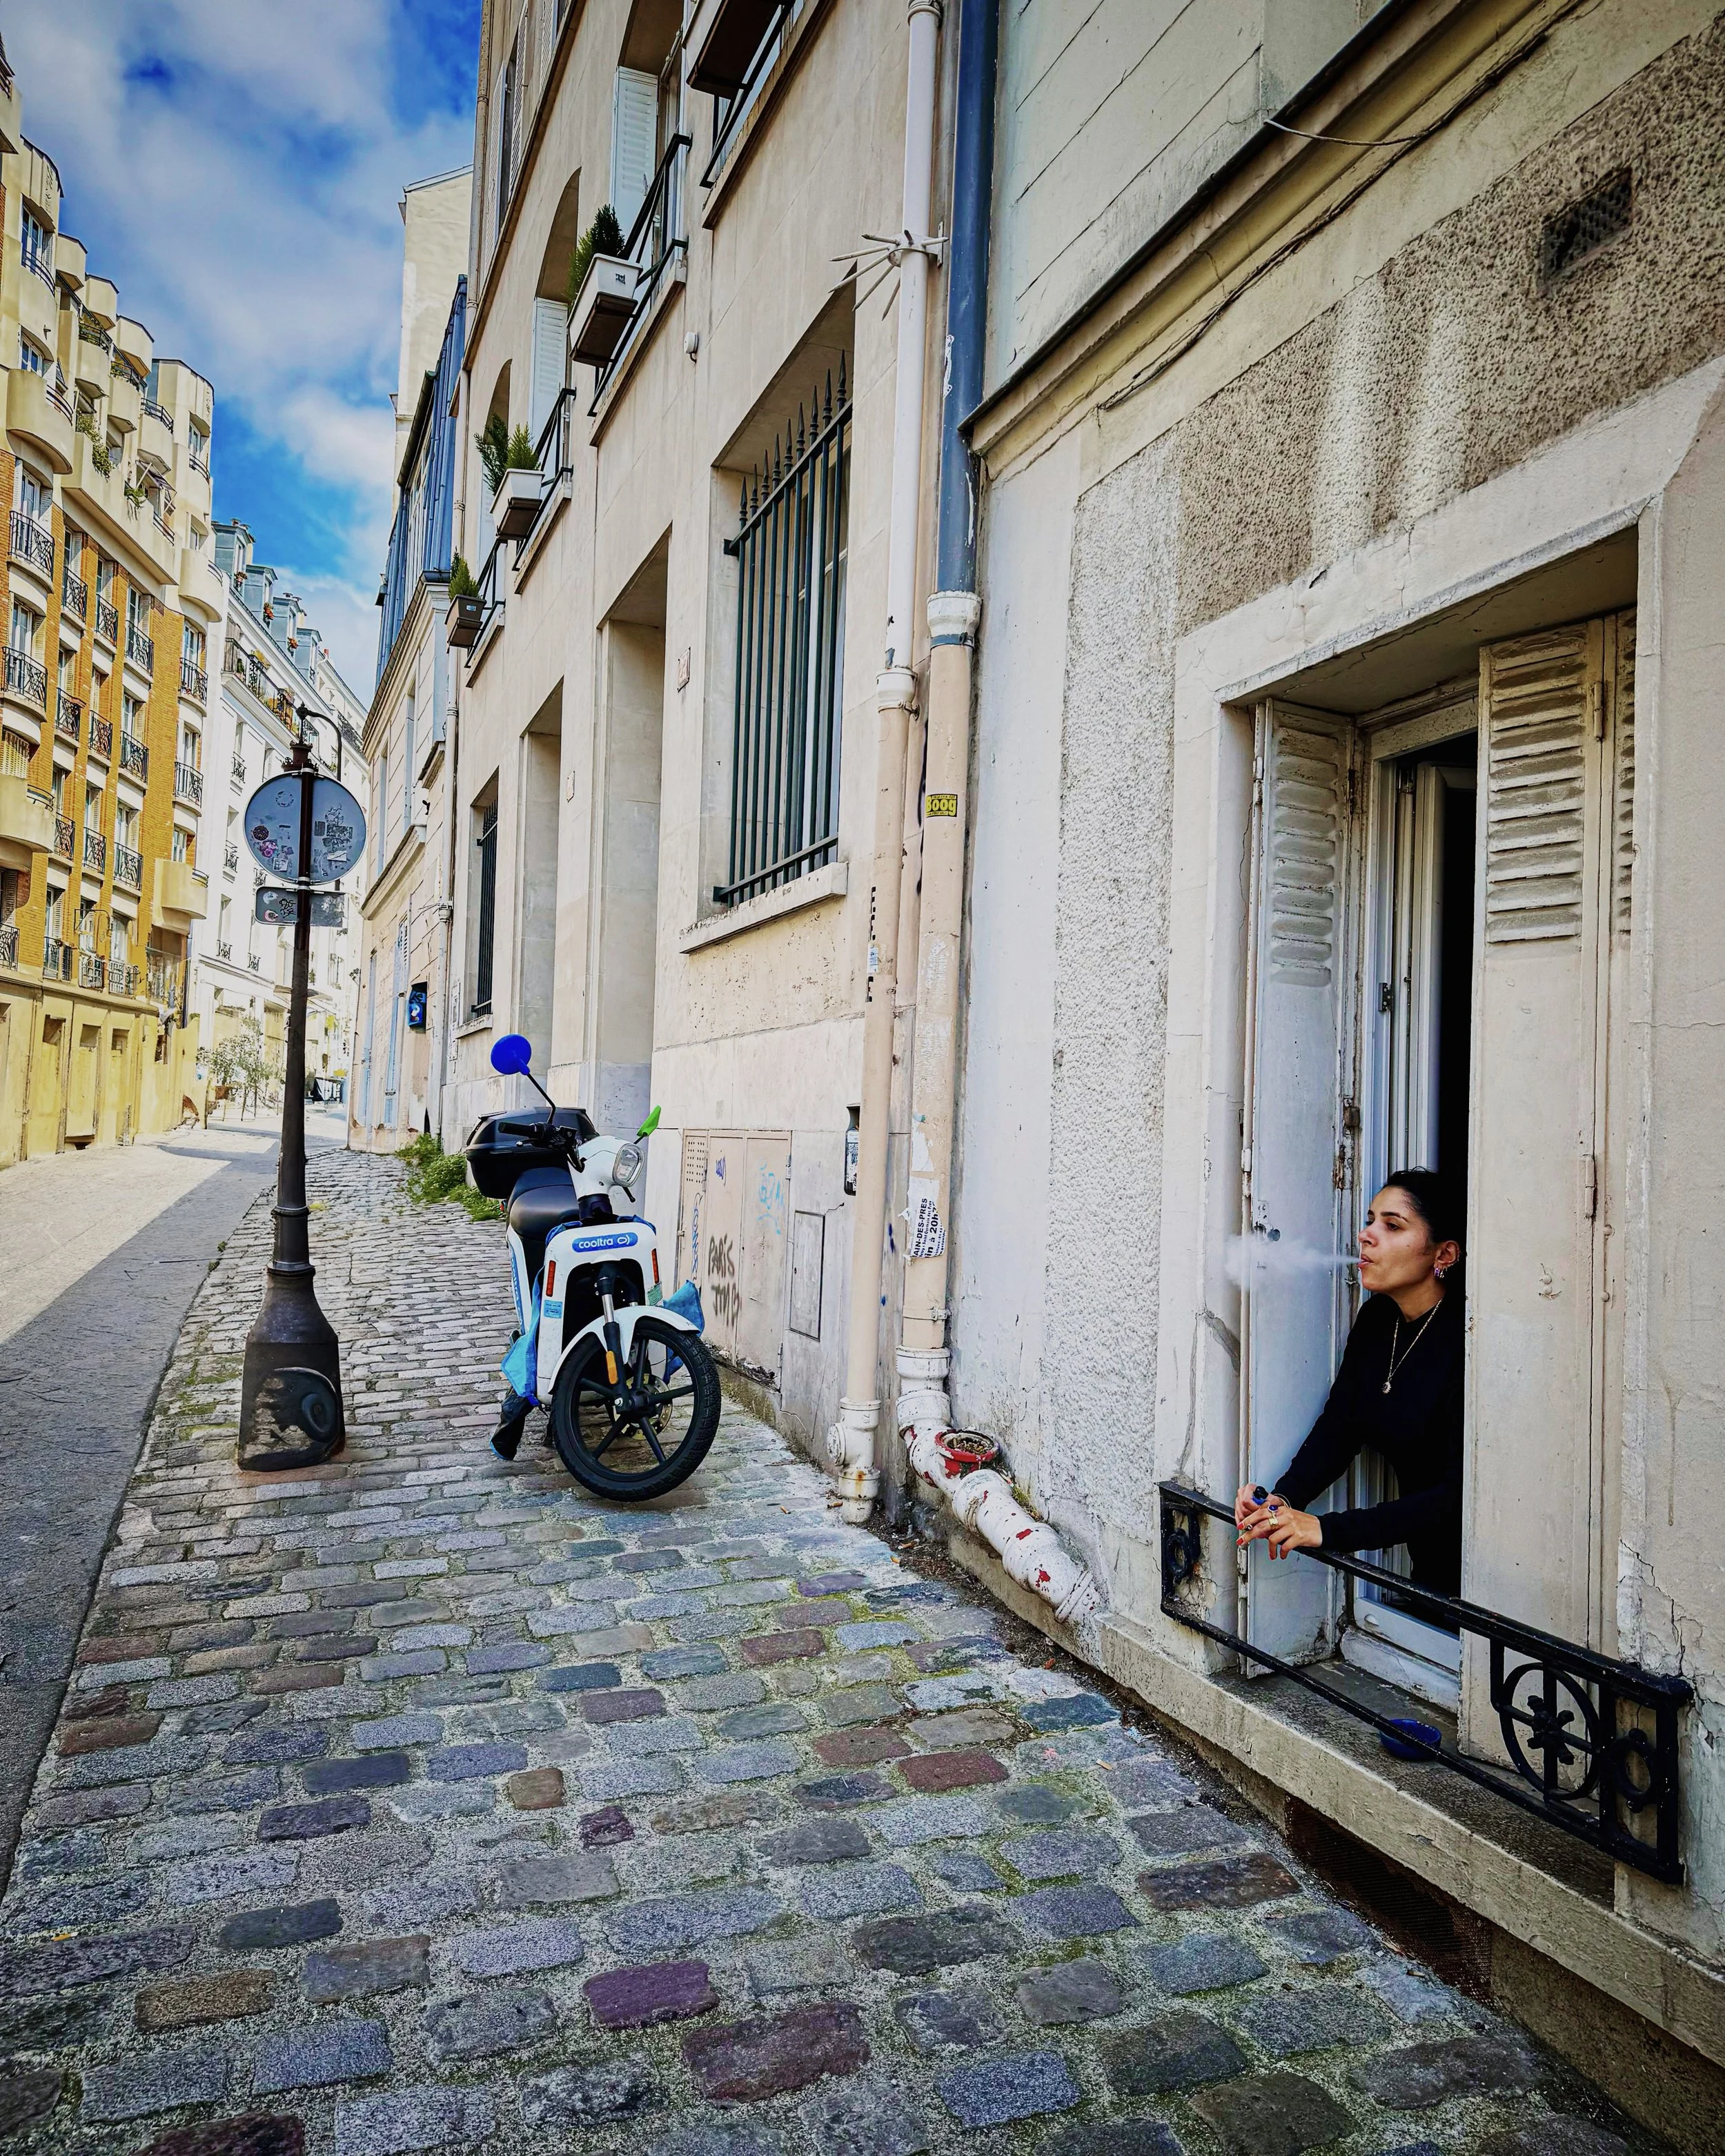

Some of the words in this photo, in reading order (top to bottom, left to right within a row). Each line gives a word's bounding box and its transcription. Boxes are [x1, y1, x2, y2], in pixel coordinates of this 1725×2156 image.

[925, 795, 957, 816] Boog
[911, 1198, 927, 1258] AIN-DES-PRES
[578, 1238, 613, 1249] cooltra
